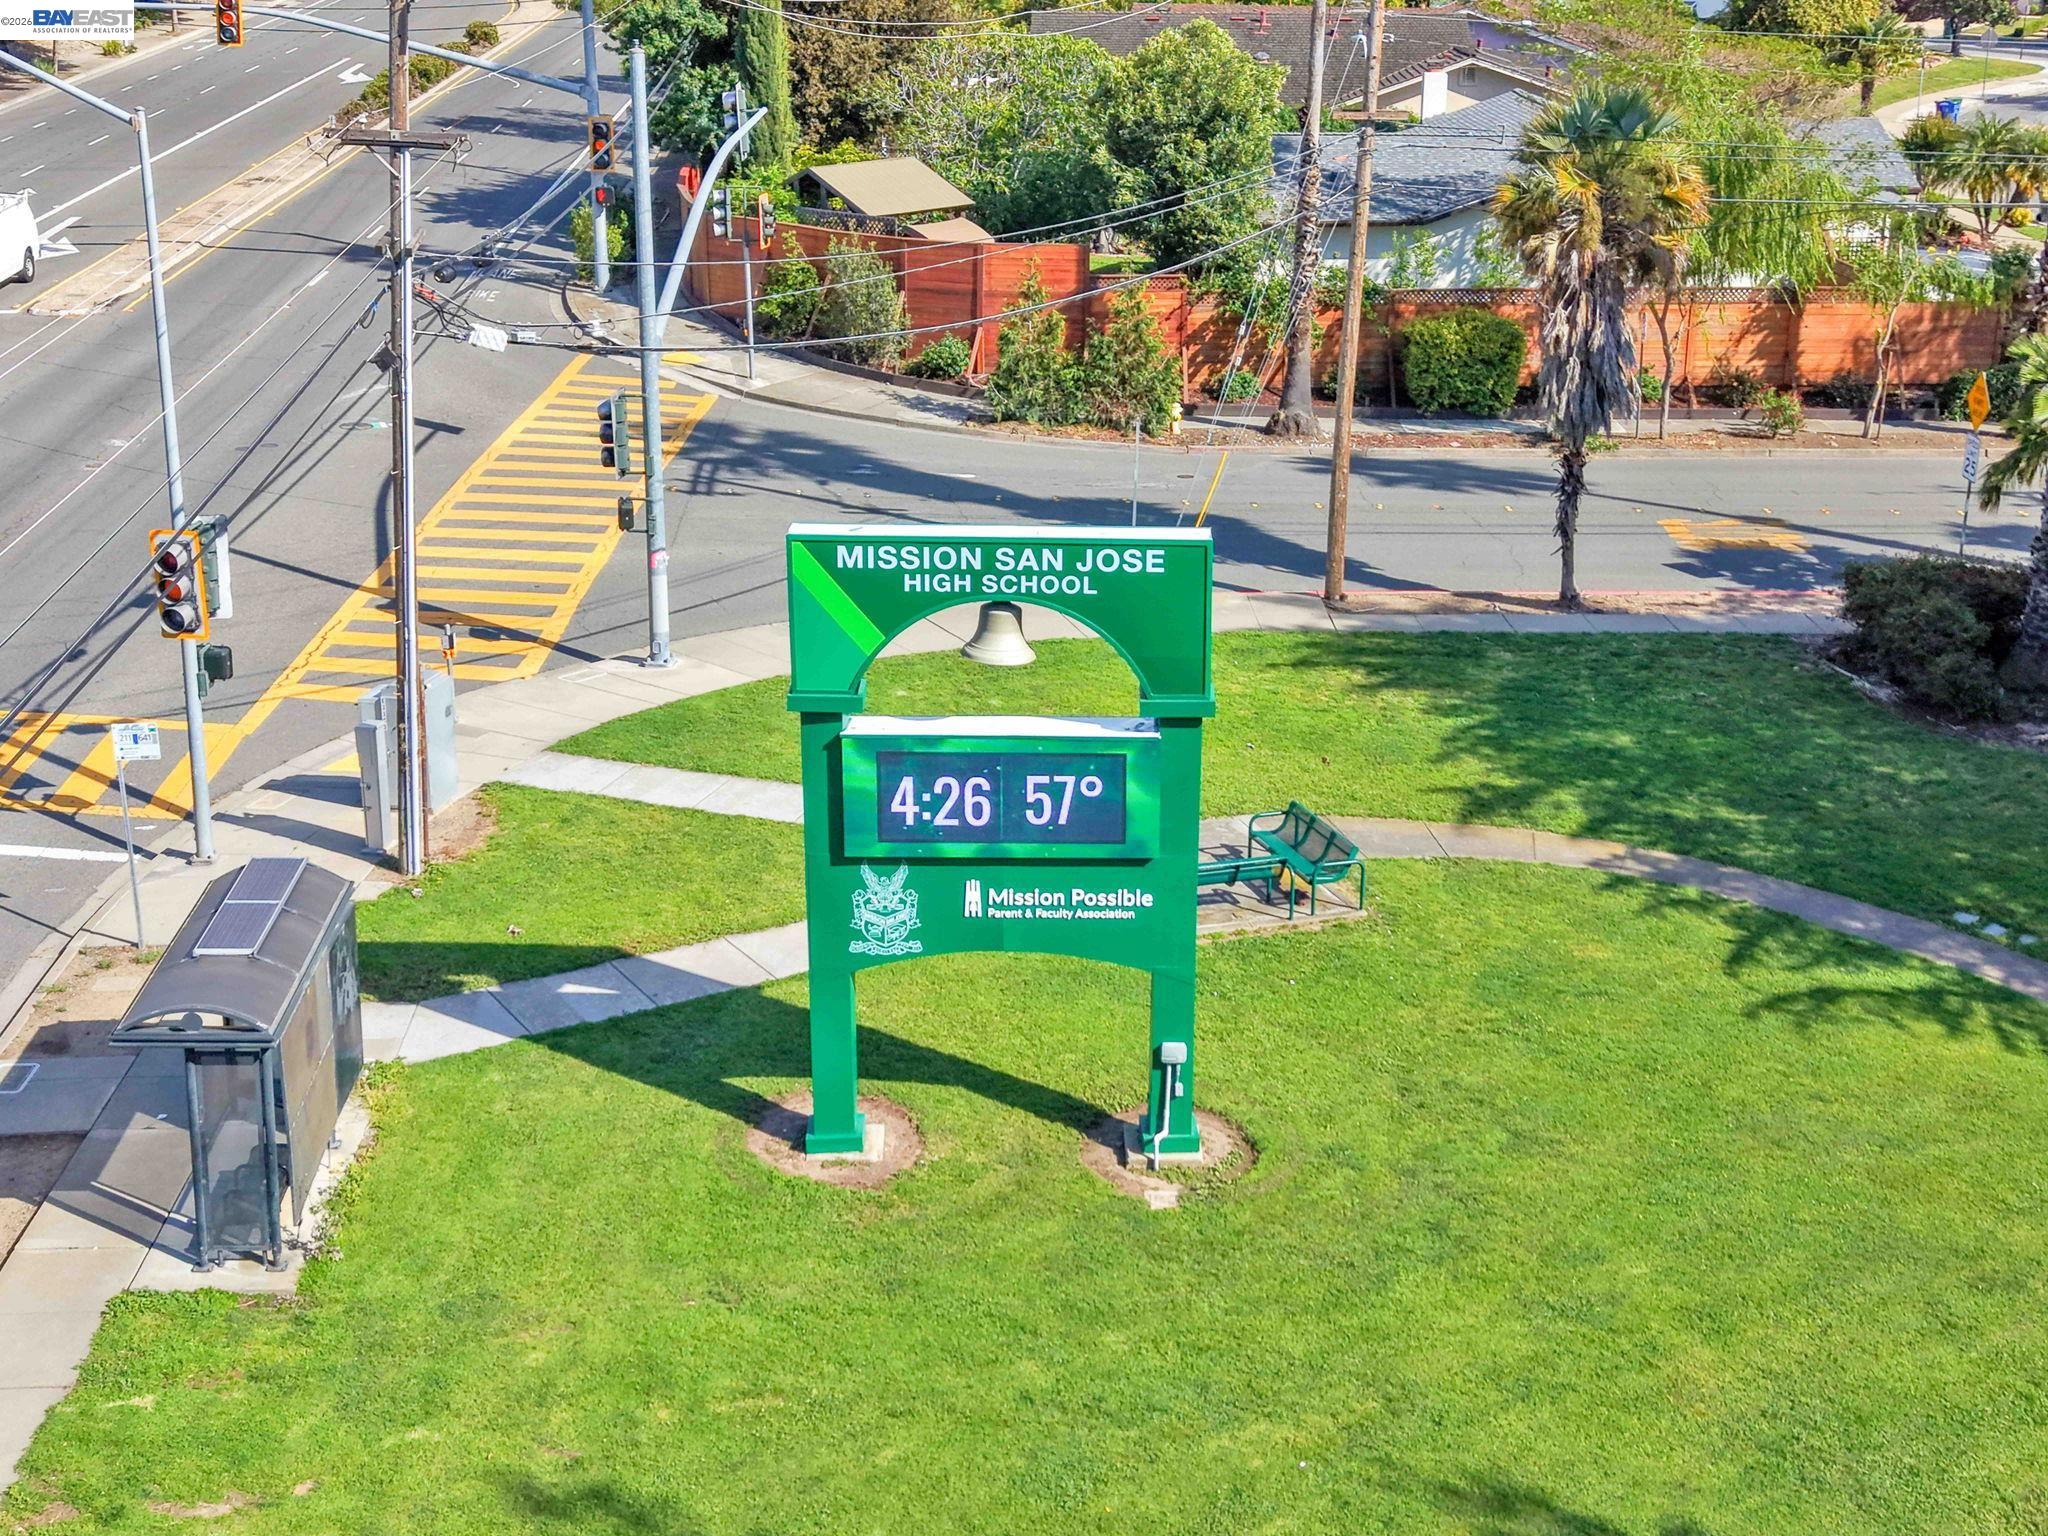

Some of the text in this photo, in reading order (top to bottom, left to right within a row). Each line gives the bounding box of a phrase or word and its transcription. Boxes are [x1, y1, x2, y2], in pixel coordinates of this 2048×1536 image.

[837, 545, 1165, 573] MISSION SAN JOSE
[904, 573, 1097, 595] HIGH SCHOOL
[890, 776, 992, 827] 4:26
[988, 888, 1154, 907] Mission Possible
[988, 908, 1135, 920] Parent & Faculty Association
